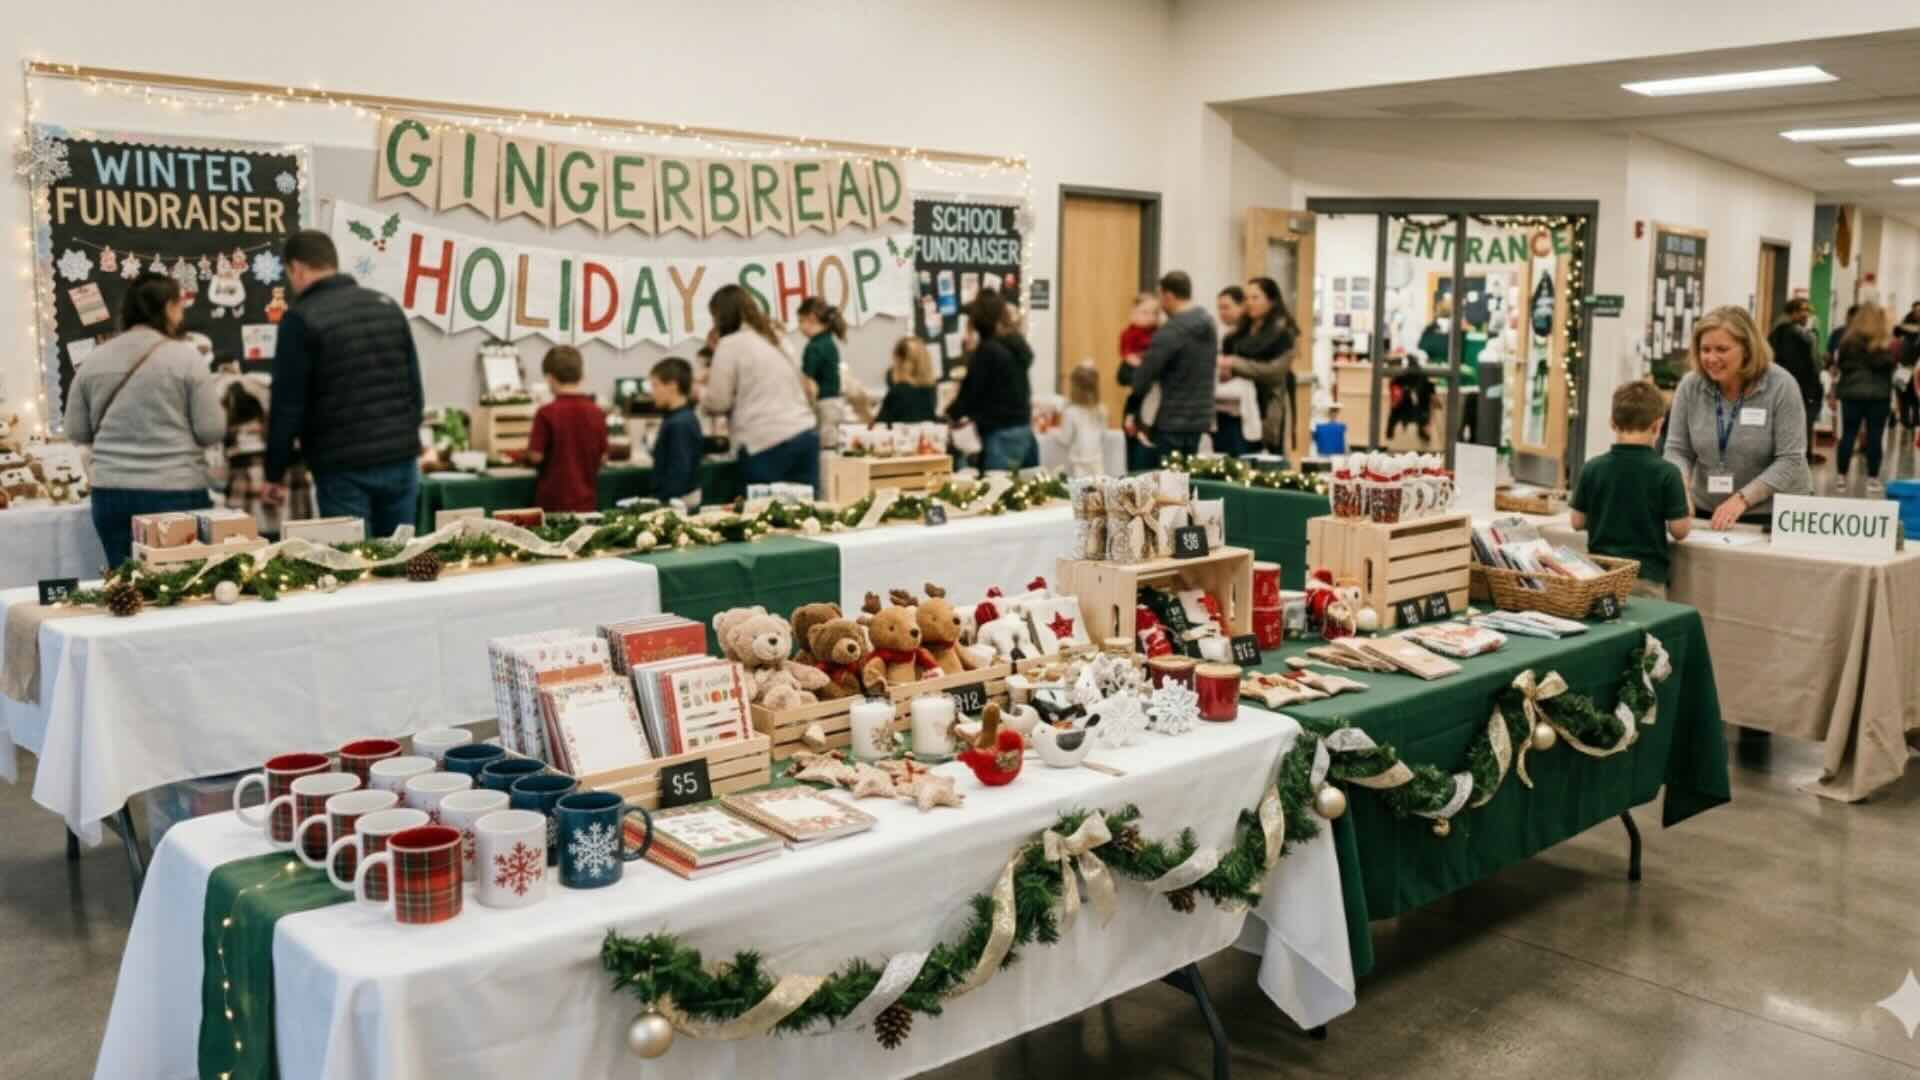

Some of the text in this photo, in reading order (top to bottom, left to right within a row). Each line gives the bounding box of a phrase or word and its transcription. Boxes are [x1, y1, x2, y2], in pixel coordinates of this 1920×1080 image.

[92, 147, 255, 193] WINTER
[385, 118, 903, 223] GINGERBREAD
[56, 186, 287, 233] FUNDRAISER
[931, 205, 1007, 236] SCHOOL
[913, 234, 1021, 266] FUNDRAISER
[1397, 223, 1571, 264] ENTRANCE
[402, 232, 881, 335] HOLIDAY SHOP
[1777, 510, 1890, 538] CHECKOUT
[672, 771, 699, 796] $5
